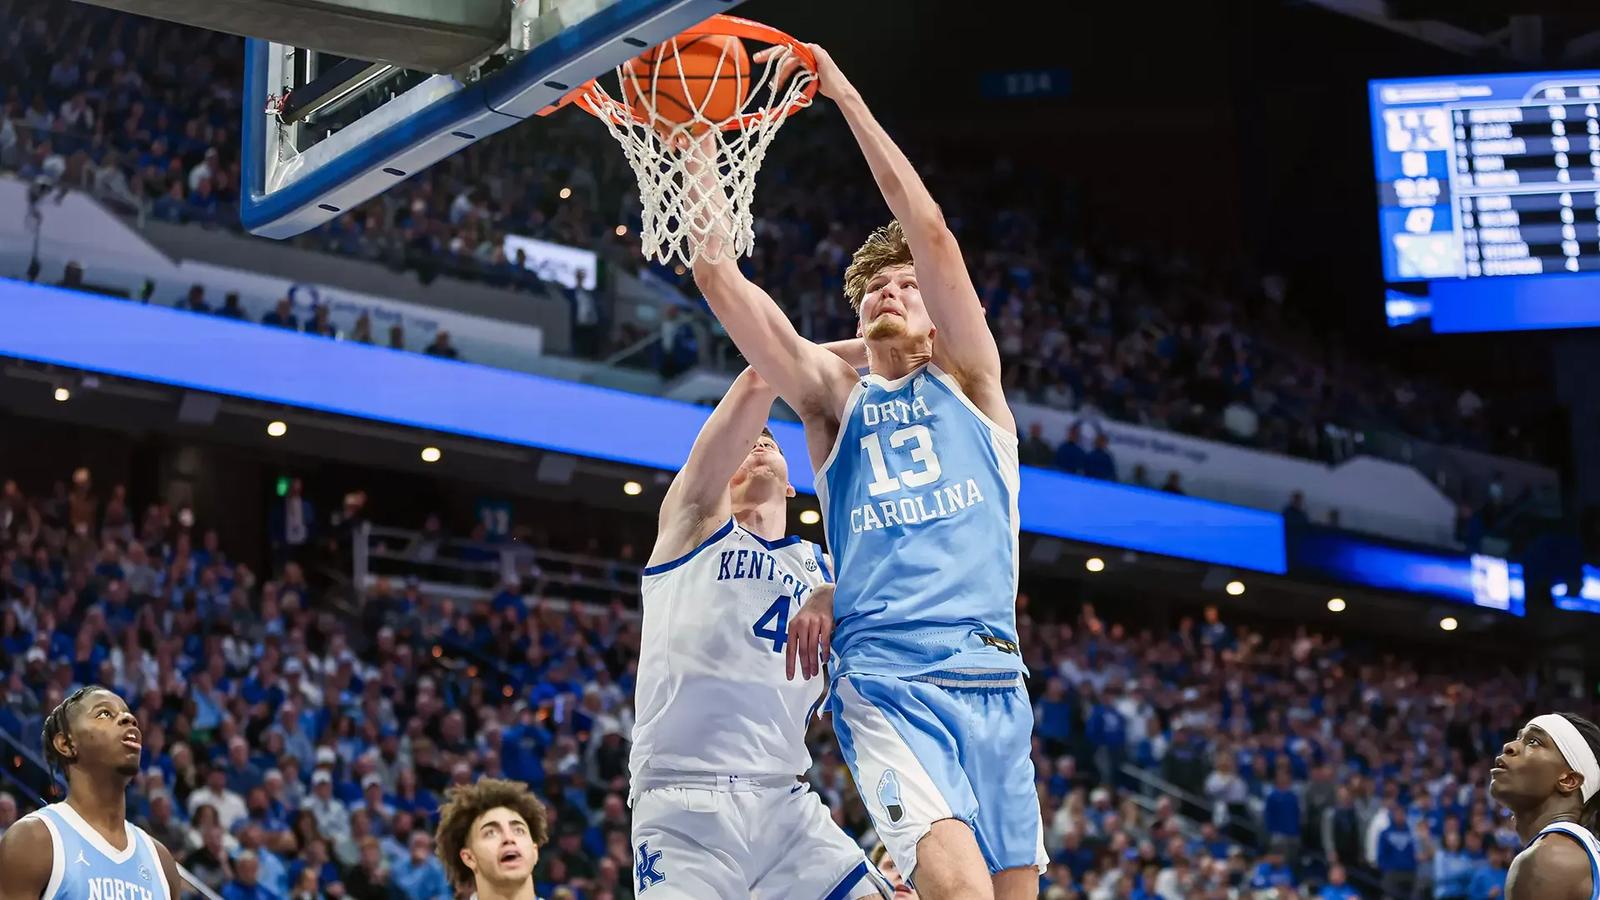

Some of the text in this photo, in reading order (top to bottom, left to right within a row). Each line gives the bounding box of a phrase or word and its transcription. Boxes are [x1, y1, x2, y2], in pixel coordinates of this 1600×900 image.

[863, 395, 933, 426] ORTH
[860, 424, 941, 496] 13
[850, 478, 984, 533] CAROLINA
[717, 549, 812, 606] KENTCK
[752, 595, 788, 653] 4
